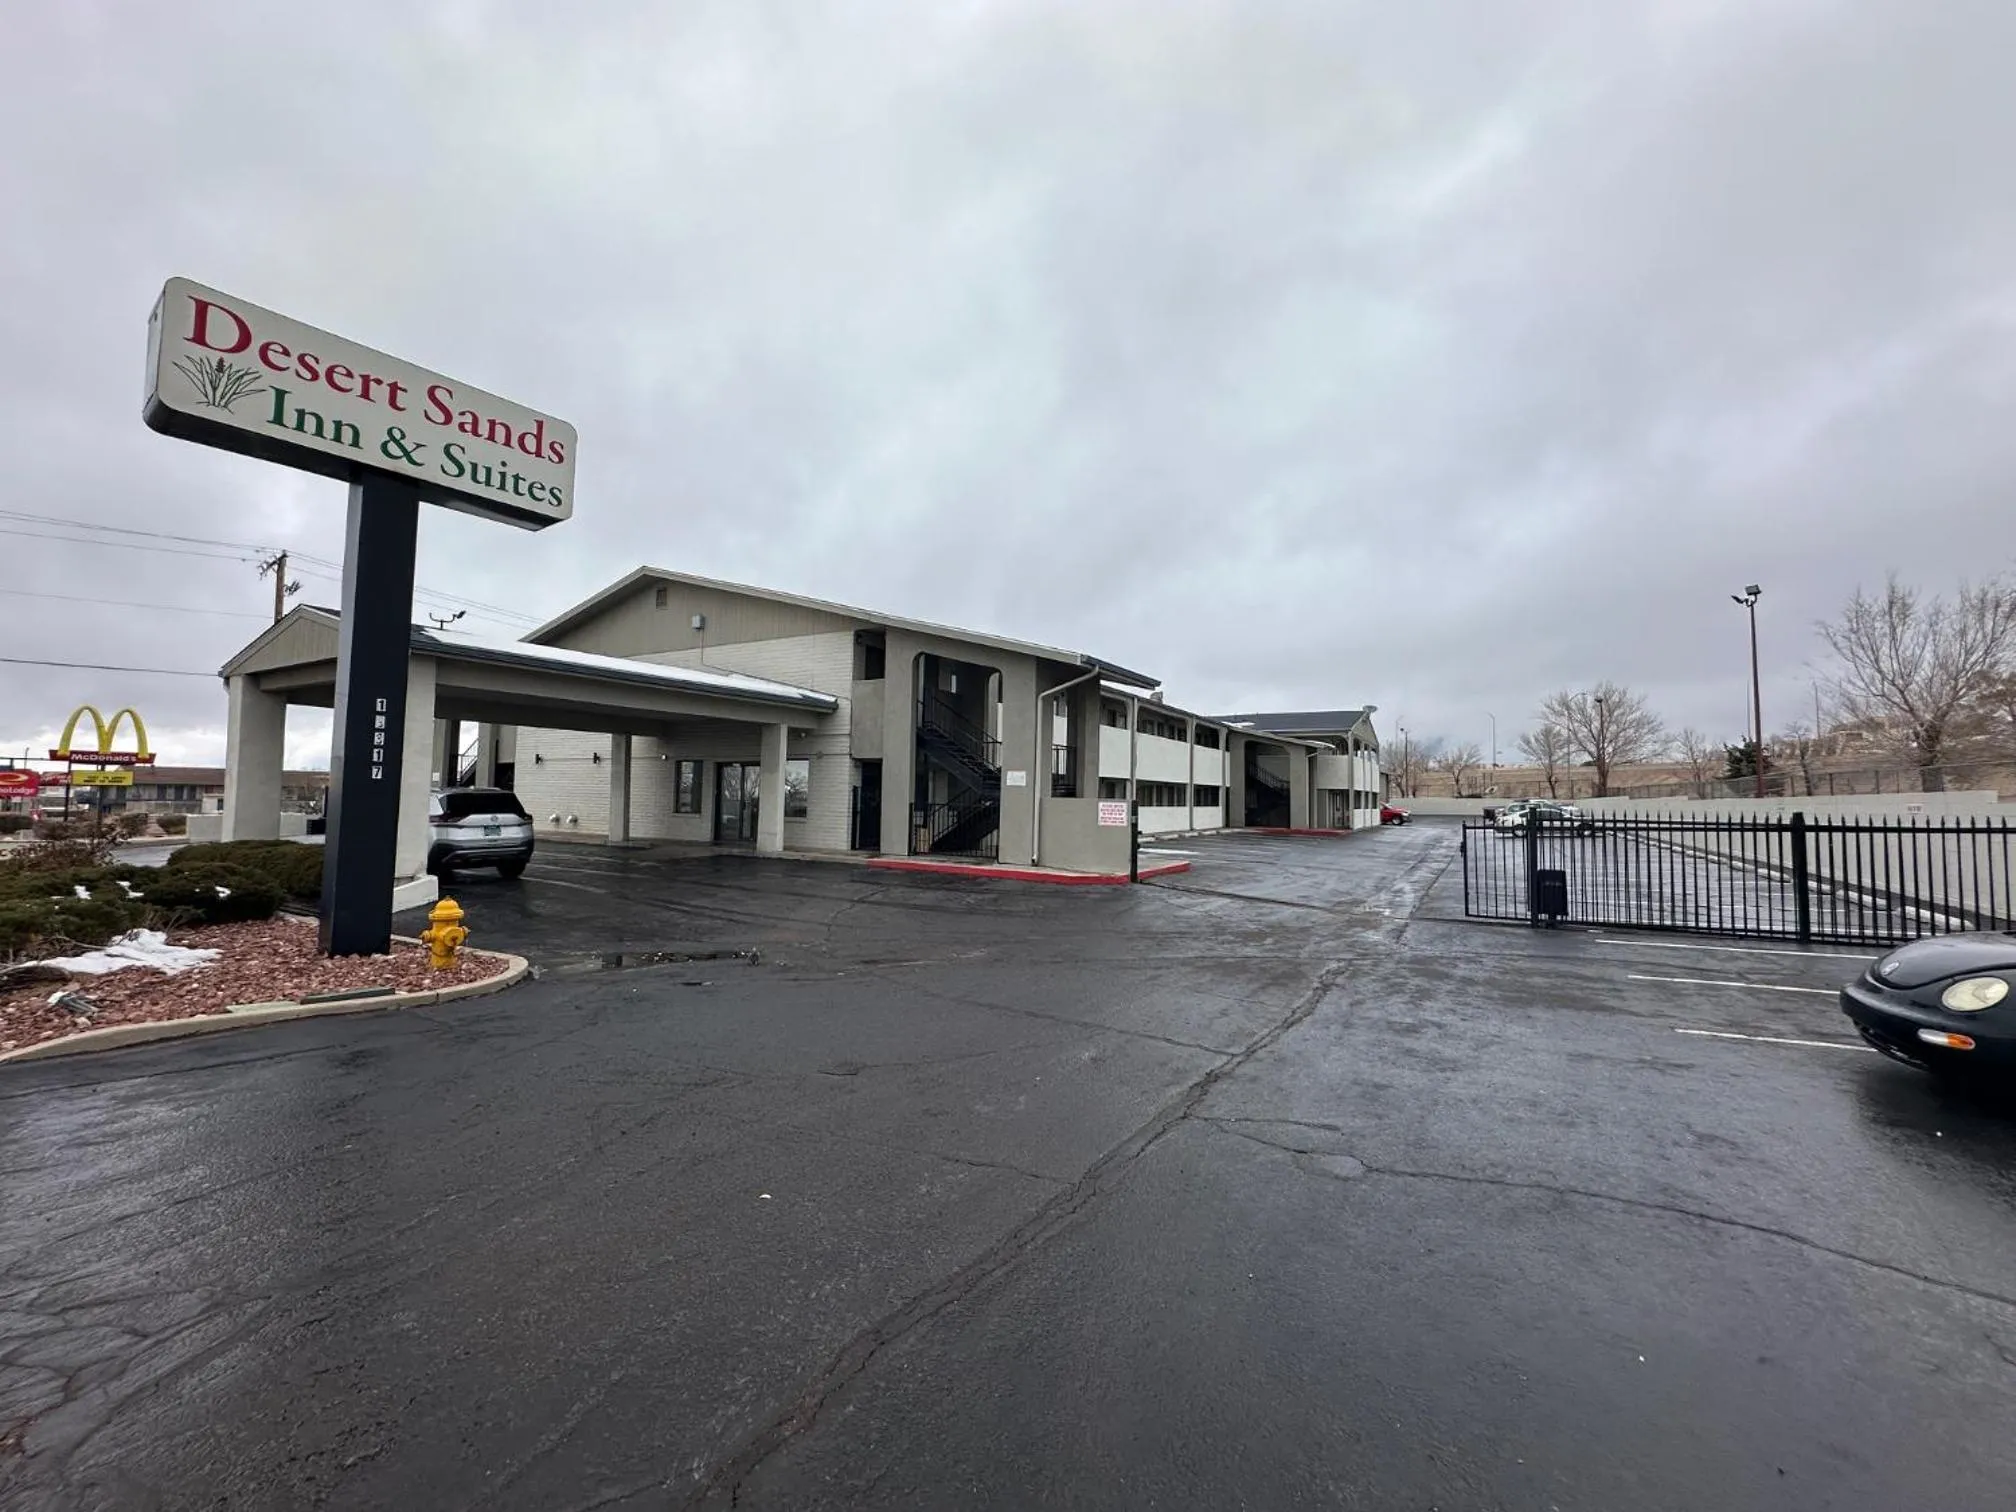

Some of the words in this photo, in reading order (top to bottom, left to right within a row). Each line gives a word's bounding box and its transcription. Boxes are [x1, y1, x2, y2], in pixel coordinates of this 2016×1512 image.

[183, 295, 407, 412] Desert
[424, 384, 565, 465] Sands
[266, 385, 364, 450] Inn
[380, 426, 426, 467] &
[440, 442, 563, 508] Suites
[71, 753, 137, 762] McDonald's
